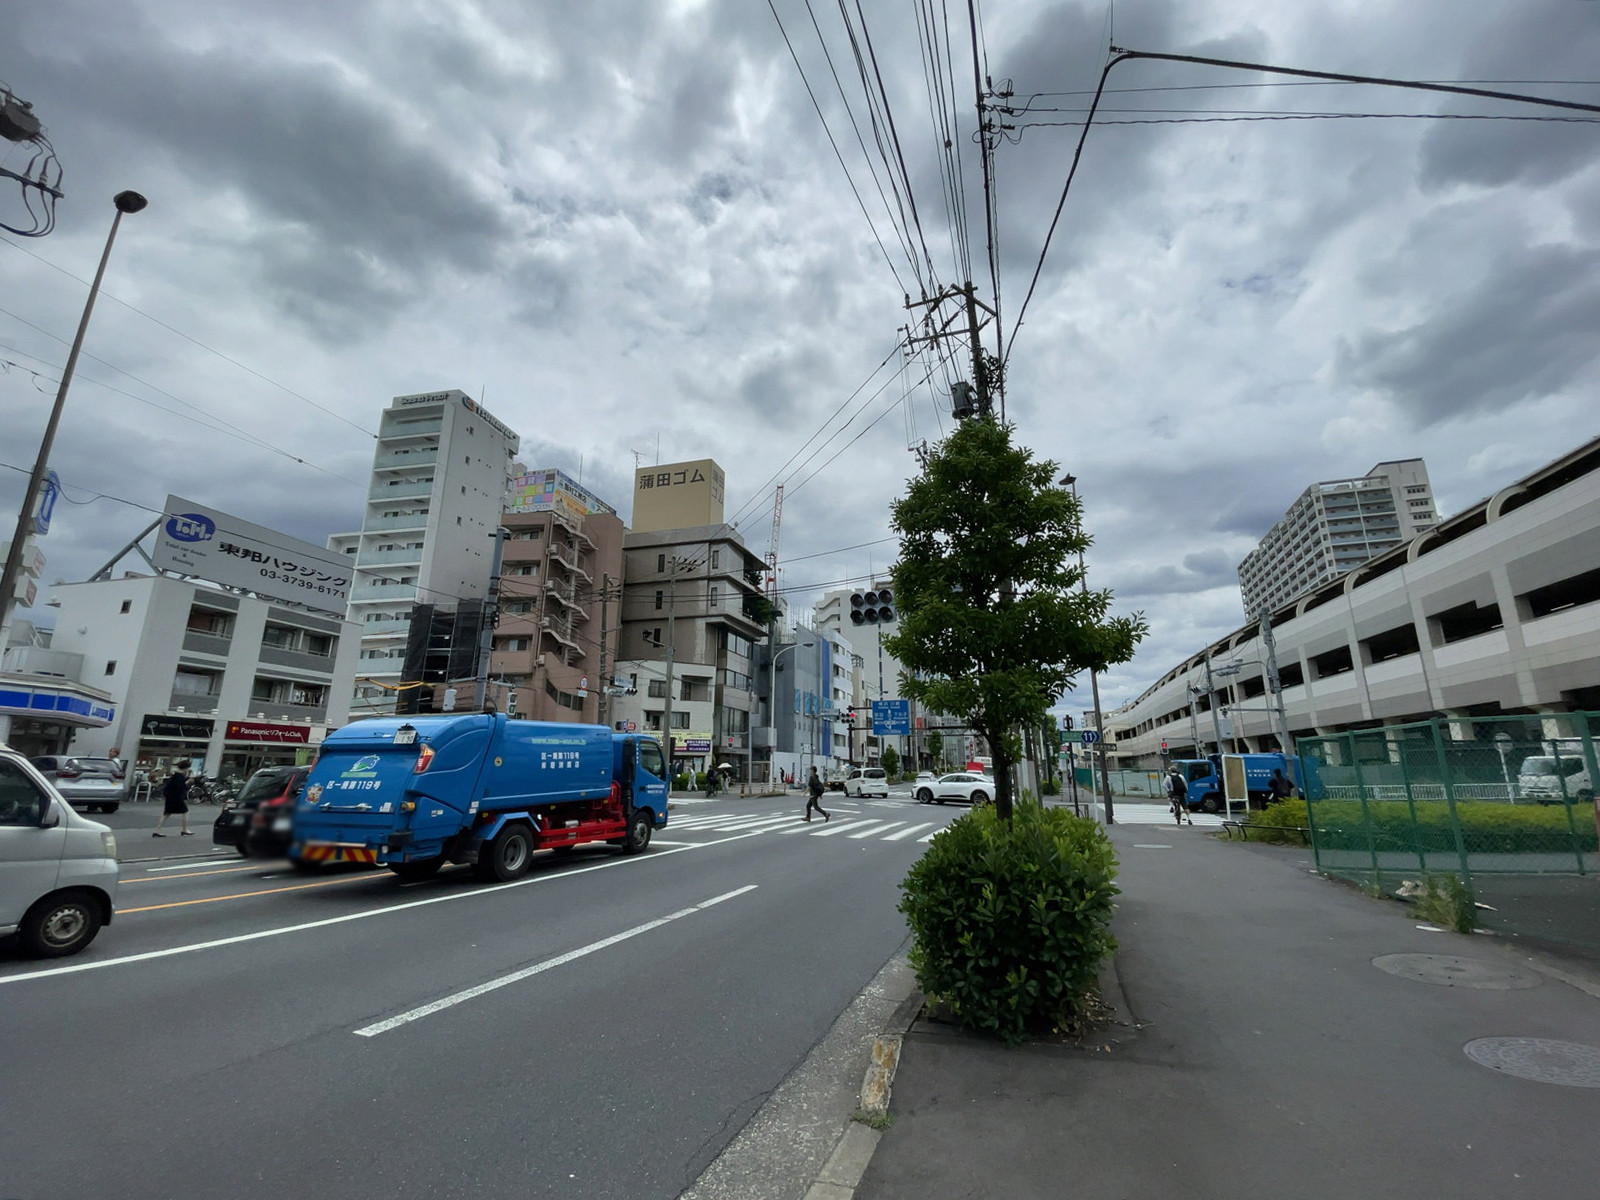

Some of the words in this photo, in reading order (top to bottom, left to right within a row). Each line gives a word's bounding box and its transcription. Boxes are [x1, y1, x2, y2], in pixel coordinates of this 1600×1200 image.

[639, 468, 706, 490] 蒲田ゴム
[218, 541, 347, 587] 東邦ハウジング
[259, 568, 346, 599] 03-3739-6171
[240, 727, 270, 736] Panasonic
[1083, 732, 1093, 741] 11
